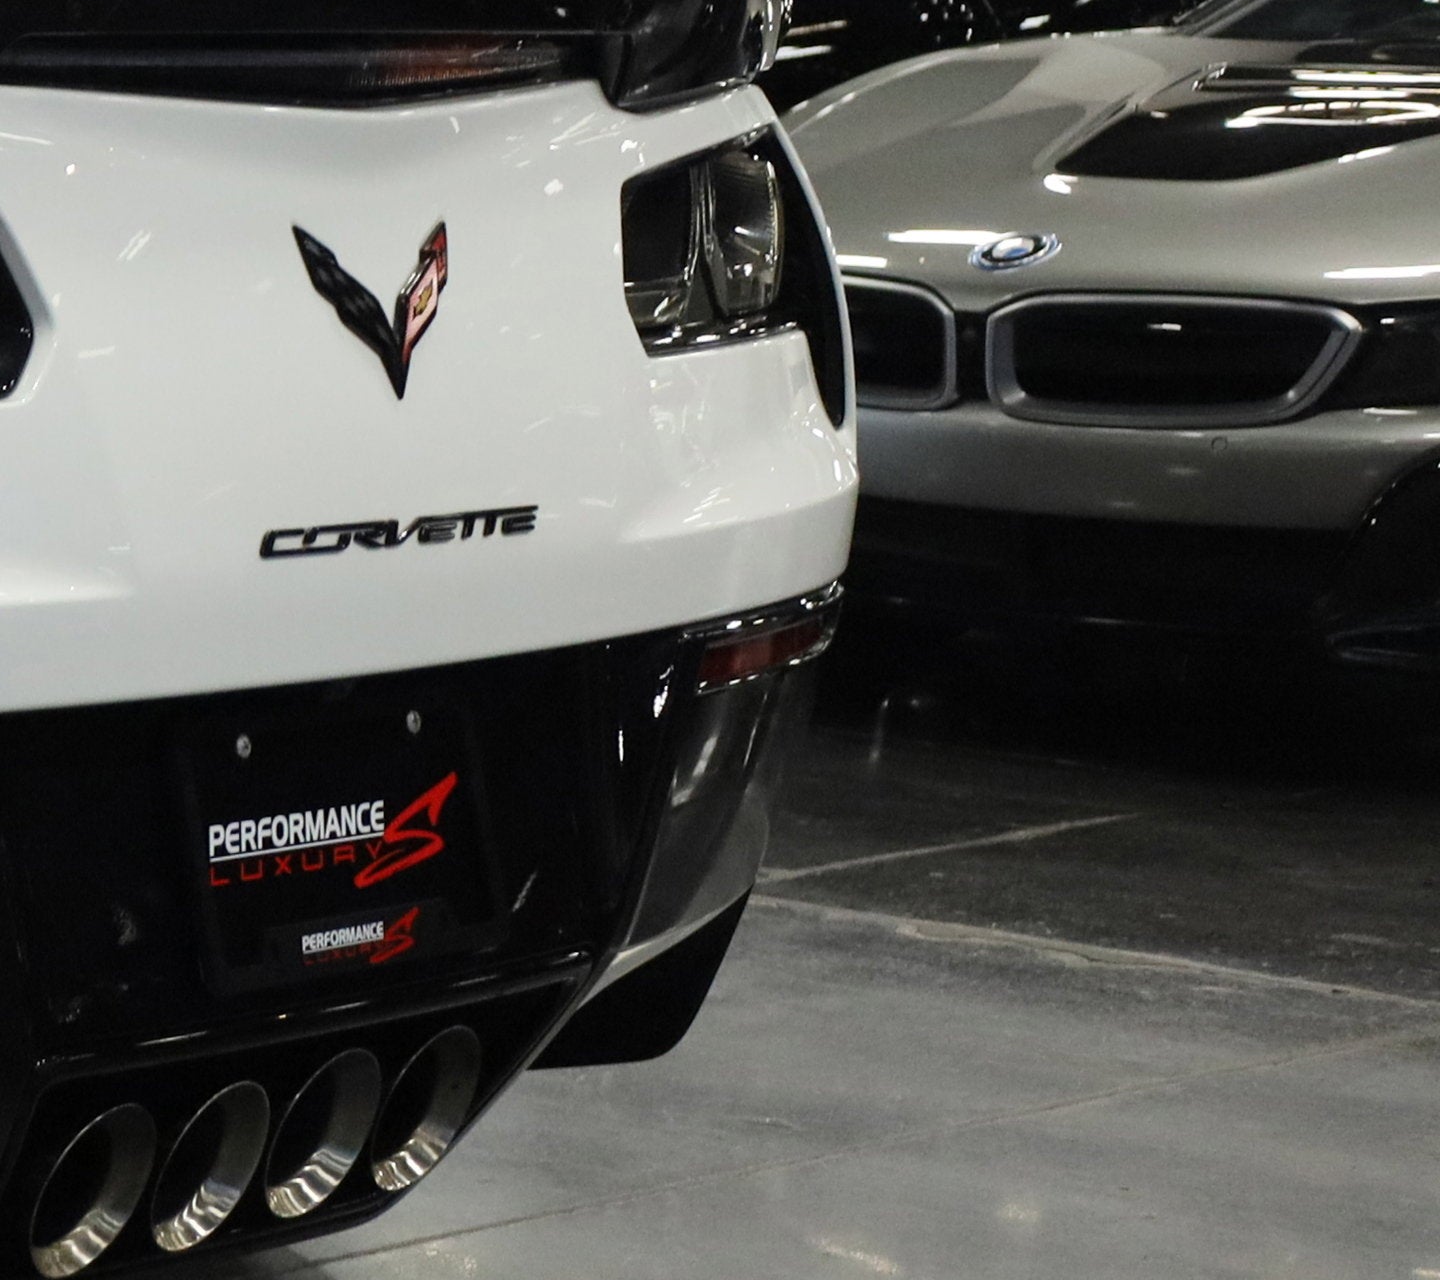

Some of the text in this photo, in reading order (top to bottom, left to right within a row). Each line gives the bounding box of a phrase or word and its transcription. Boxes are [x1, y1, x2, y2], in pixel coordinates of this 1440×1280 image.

[259, 505, 539, 559] CORVETTE
[209, 799, 384, 858] PERFORMANCE
[210, 841, 383, 887] LUXURY
[302, 921, 384, 952] PERFORMANCE
